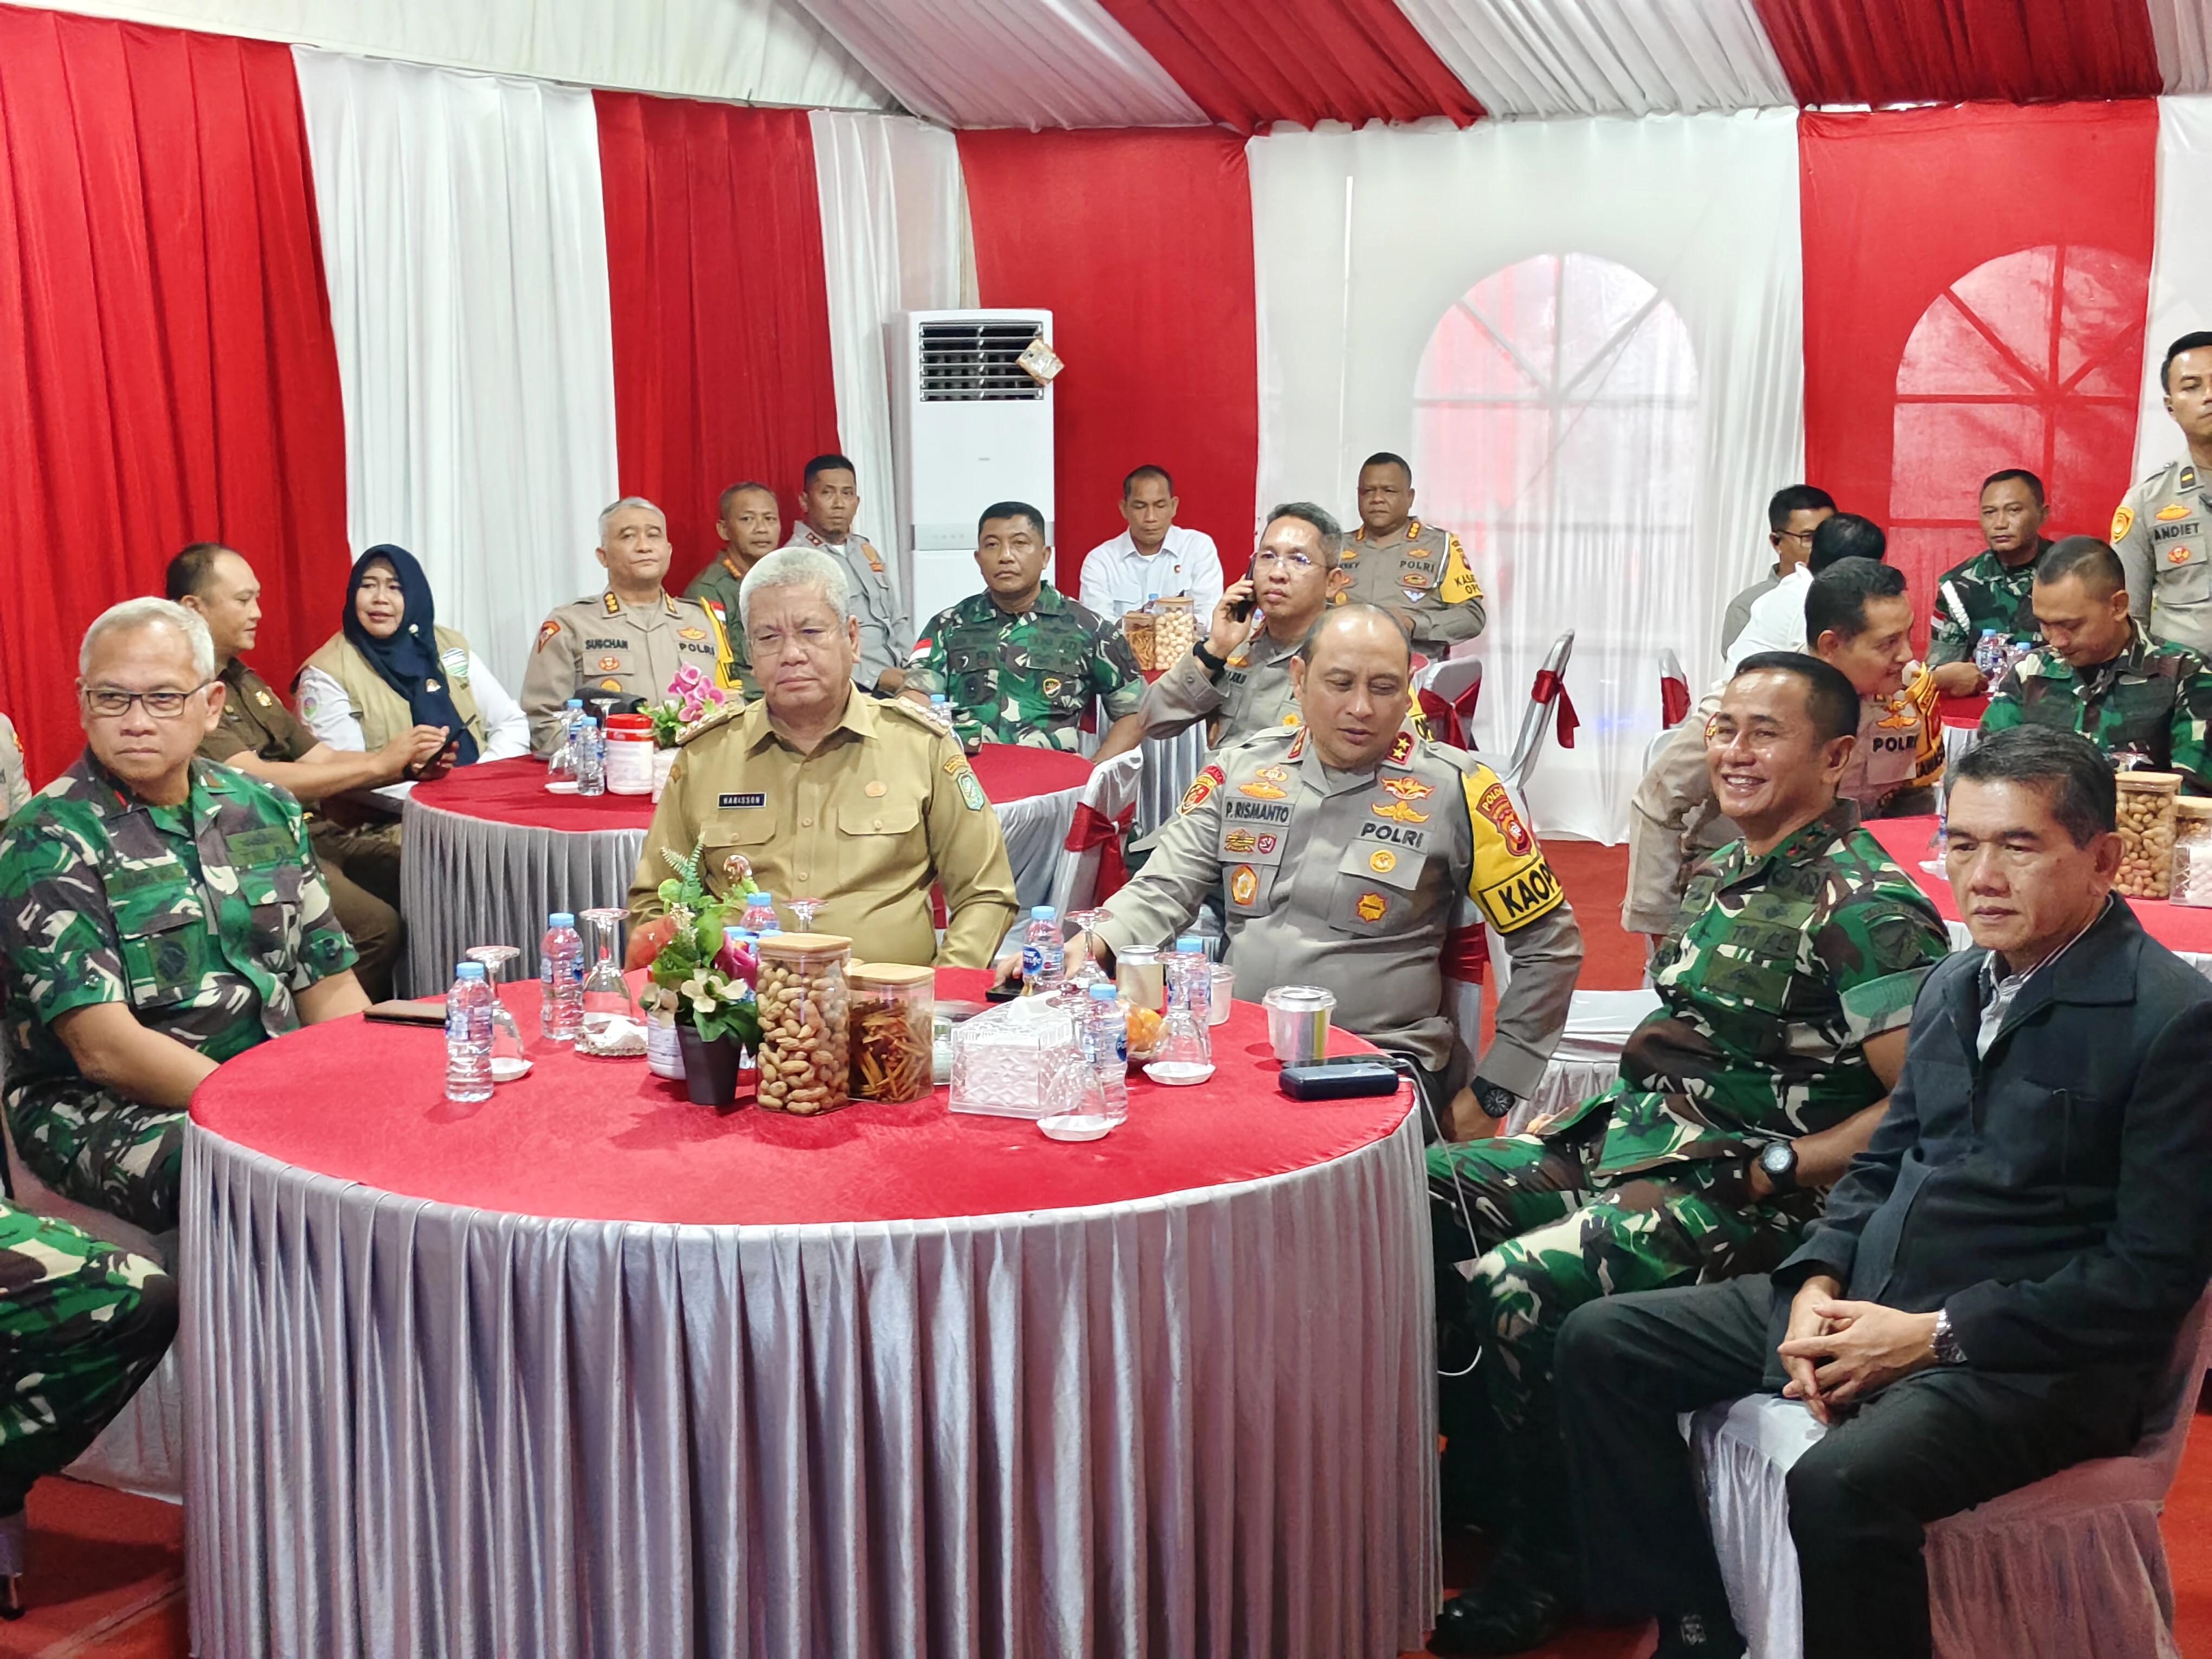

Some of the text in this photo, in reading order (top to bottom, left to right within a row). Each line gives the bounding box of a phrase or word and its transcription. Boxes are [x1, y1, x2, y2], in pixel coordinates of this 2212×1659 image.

[1399, 560, 1435, 574] POLRI
[678, 642, 715, 657] POLRI
[1360, 822, 1424, 848] POLRI
